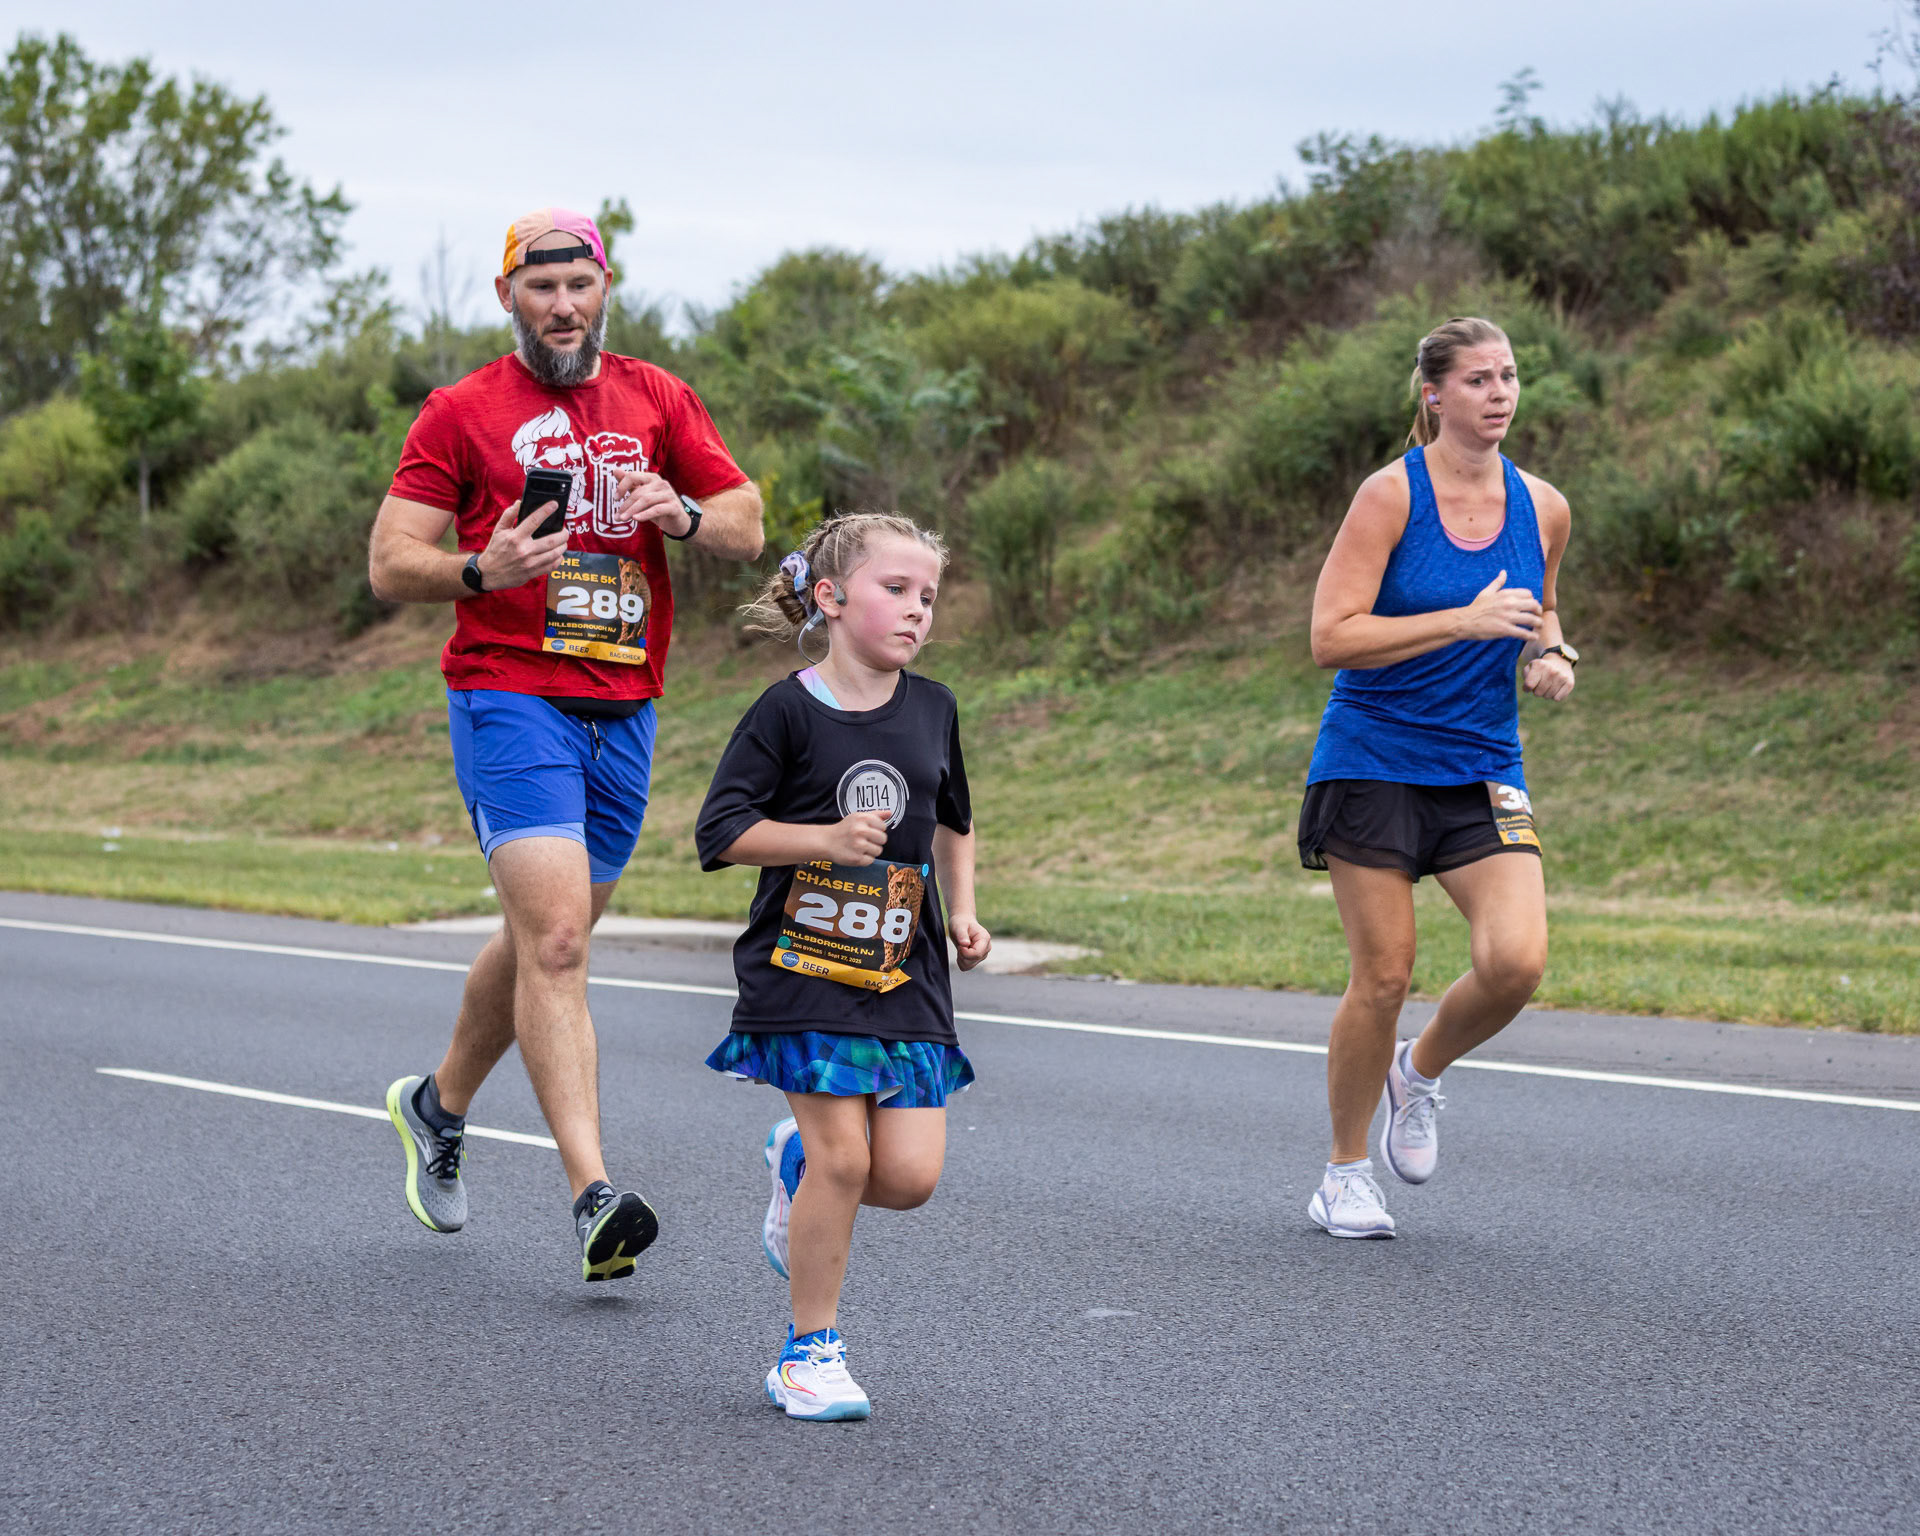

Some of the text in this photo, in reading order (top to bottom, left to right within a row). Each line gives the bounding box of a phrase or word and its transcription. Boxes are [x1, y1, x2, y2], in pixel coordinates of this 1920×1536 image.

[560, 558, 580, 567] HE
[550, 570, 617, 585] CHASE 5K
[556, 585, 644, 624] 289
[548, 621, 608, 632] HILLSBOROUGH
[568, 644, 590, 654] BEER
[609, 651, 641, 661] BAG CHECK
[856, 784, 890, 809] NJ14
[804, 860, 832, 871] HE
[796, 871, 883, 898] CHASE 5K
[794, 892, 913, 944] 288
[783, 928, 875, 956] HILLSBOROUGH, NJ
[802, 944, 823, 955] BYPASS
[827, 951, 840, 960] Sept
[802, 961, 830, 976] BEER
[864, 979, 883, 990] BAG
